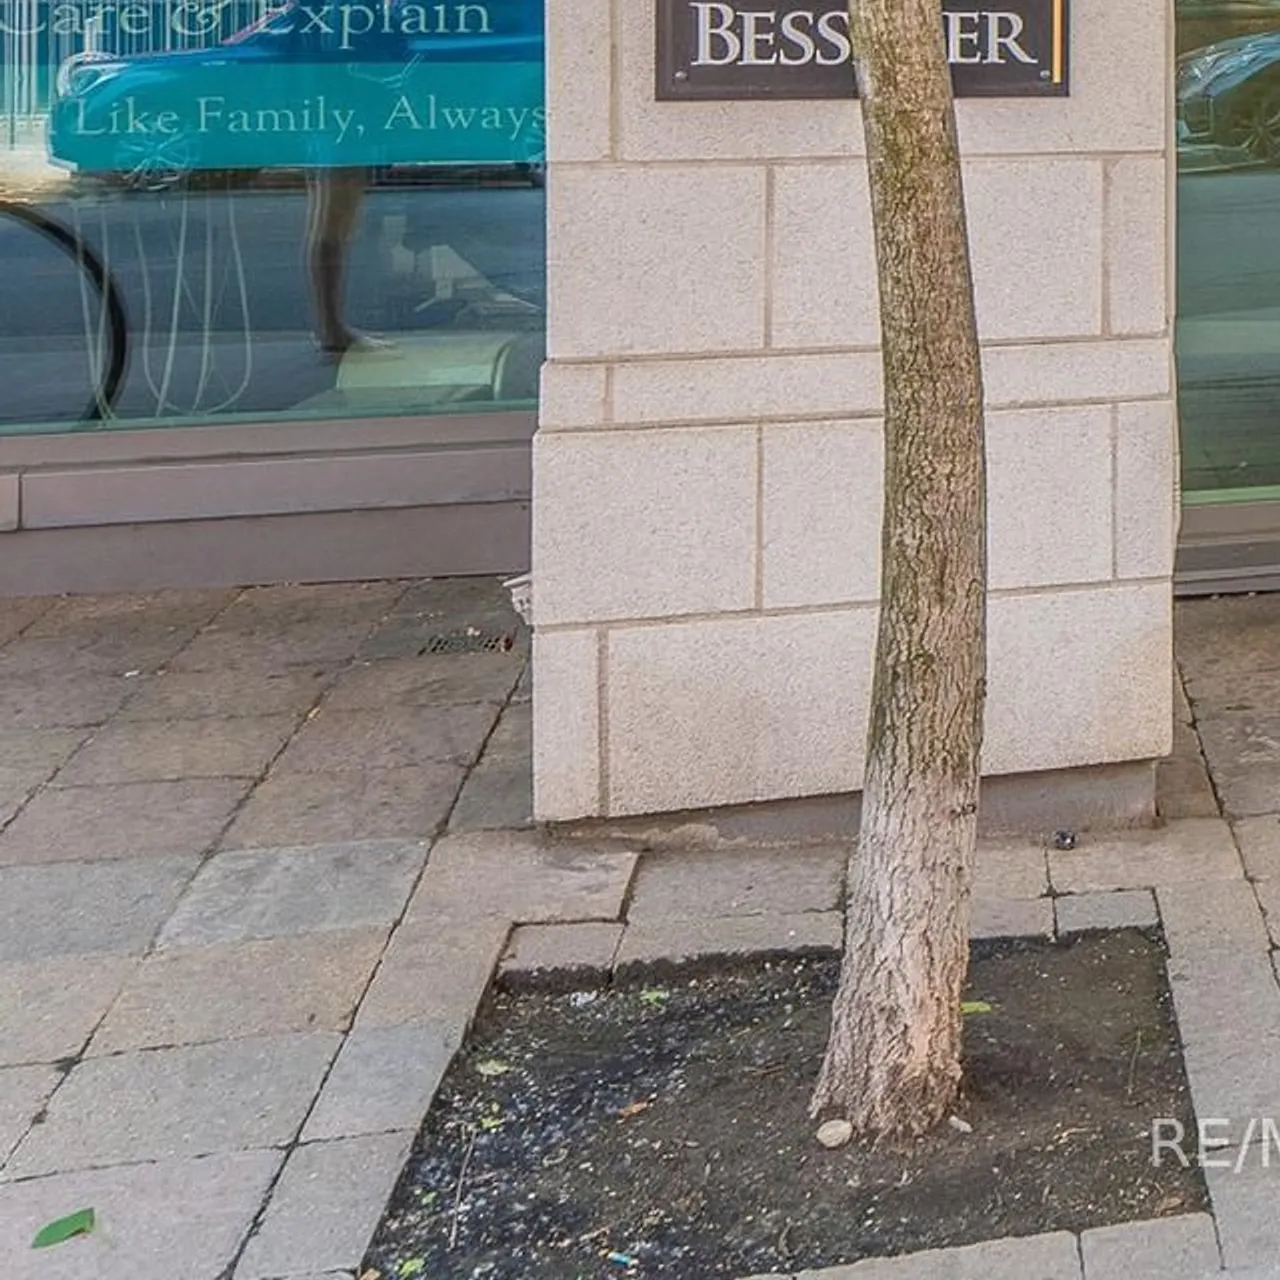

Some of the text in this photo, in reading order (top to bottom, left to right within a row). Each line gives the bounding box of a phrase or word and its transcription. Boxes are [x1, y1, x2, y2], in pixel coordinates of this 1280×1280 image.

[689, 1, 1038, 67] BESSER
[76, 94, 544, 144] Like Family, Always
